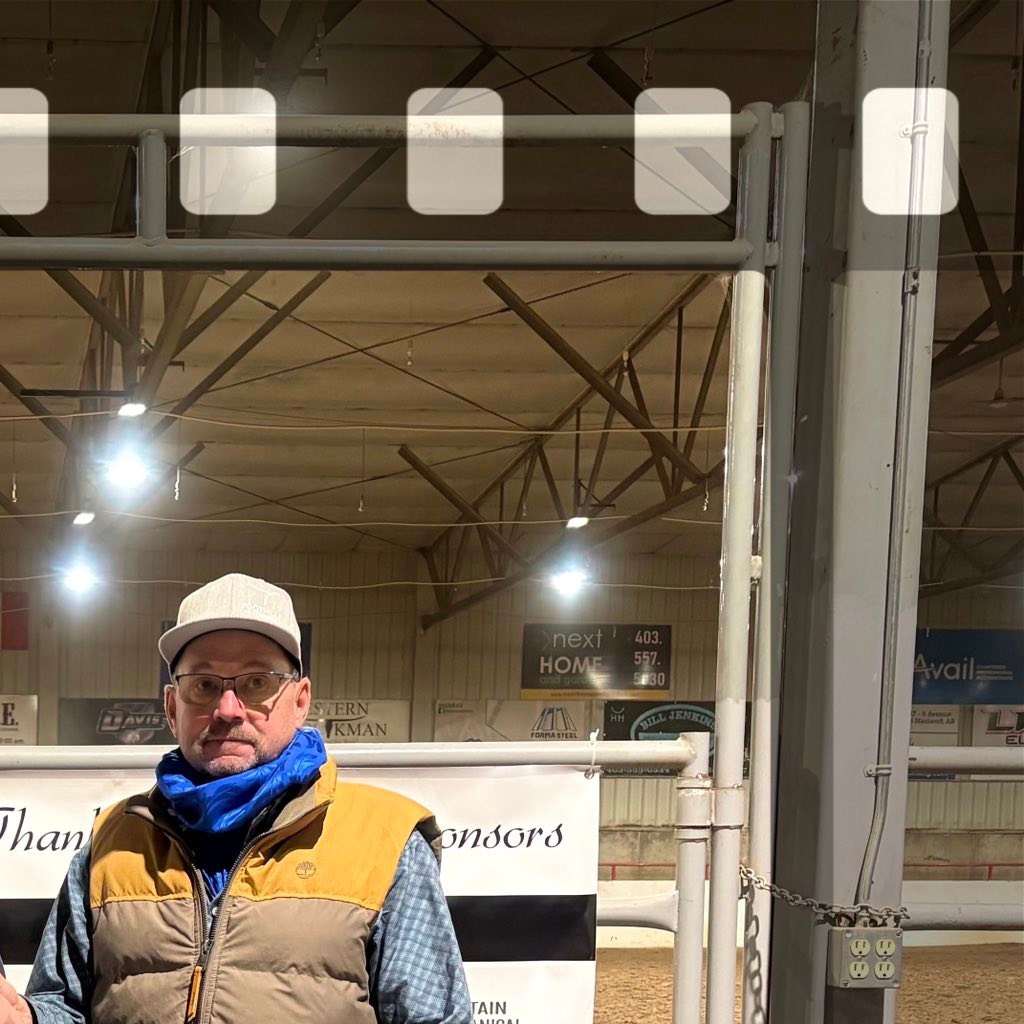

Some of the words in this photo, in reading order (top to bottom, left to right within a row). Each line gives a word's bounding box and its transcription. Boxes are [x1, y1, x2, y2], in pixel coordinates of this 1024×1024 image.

[553, 628, 603, 648] next
[634, 630, 663, 645] 403.
[539, 656, 603, 674] HOME
[633, 652, 661, 665] 557.
[913, 653, 974, 681] Avail
[639, 712, 667, 731] BILL
